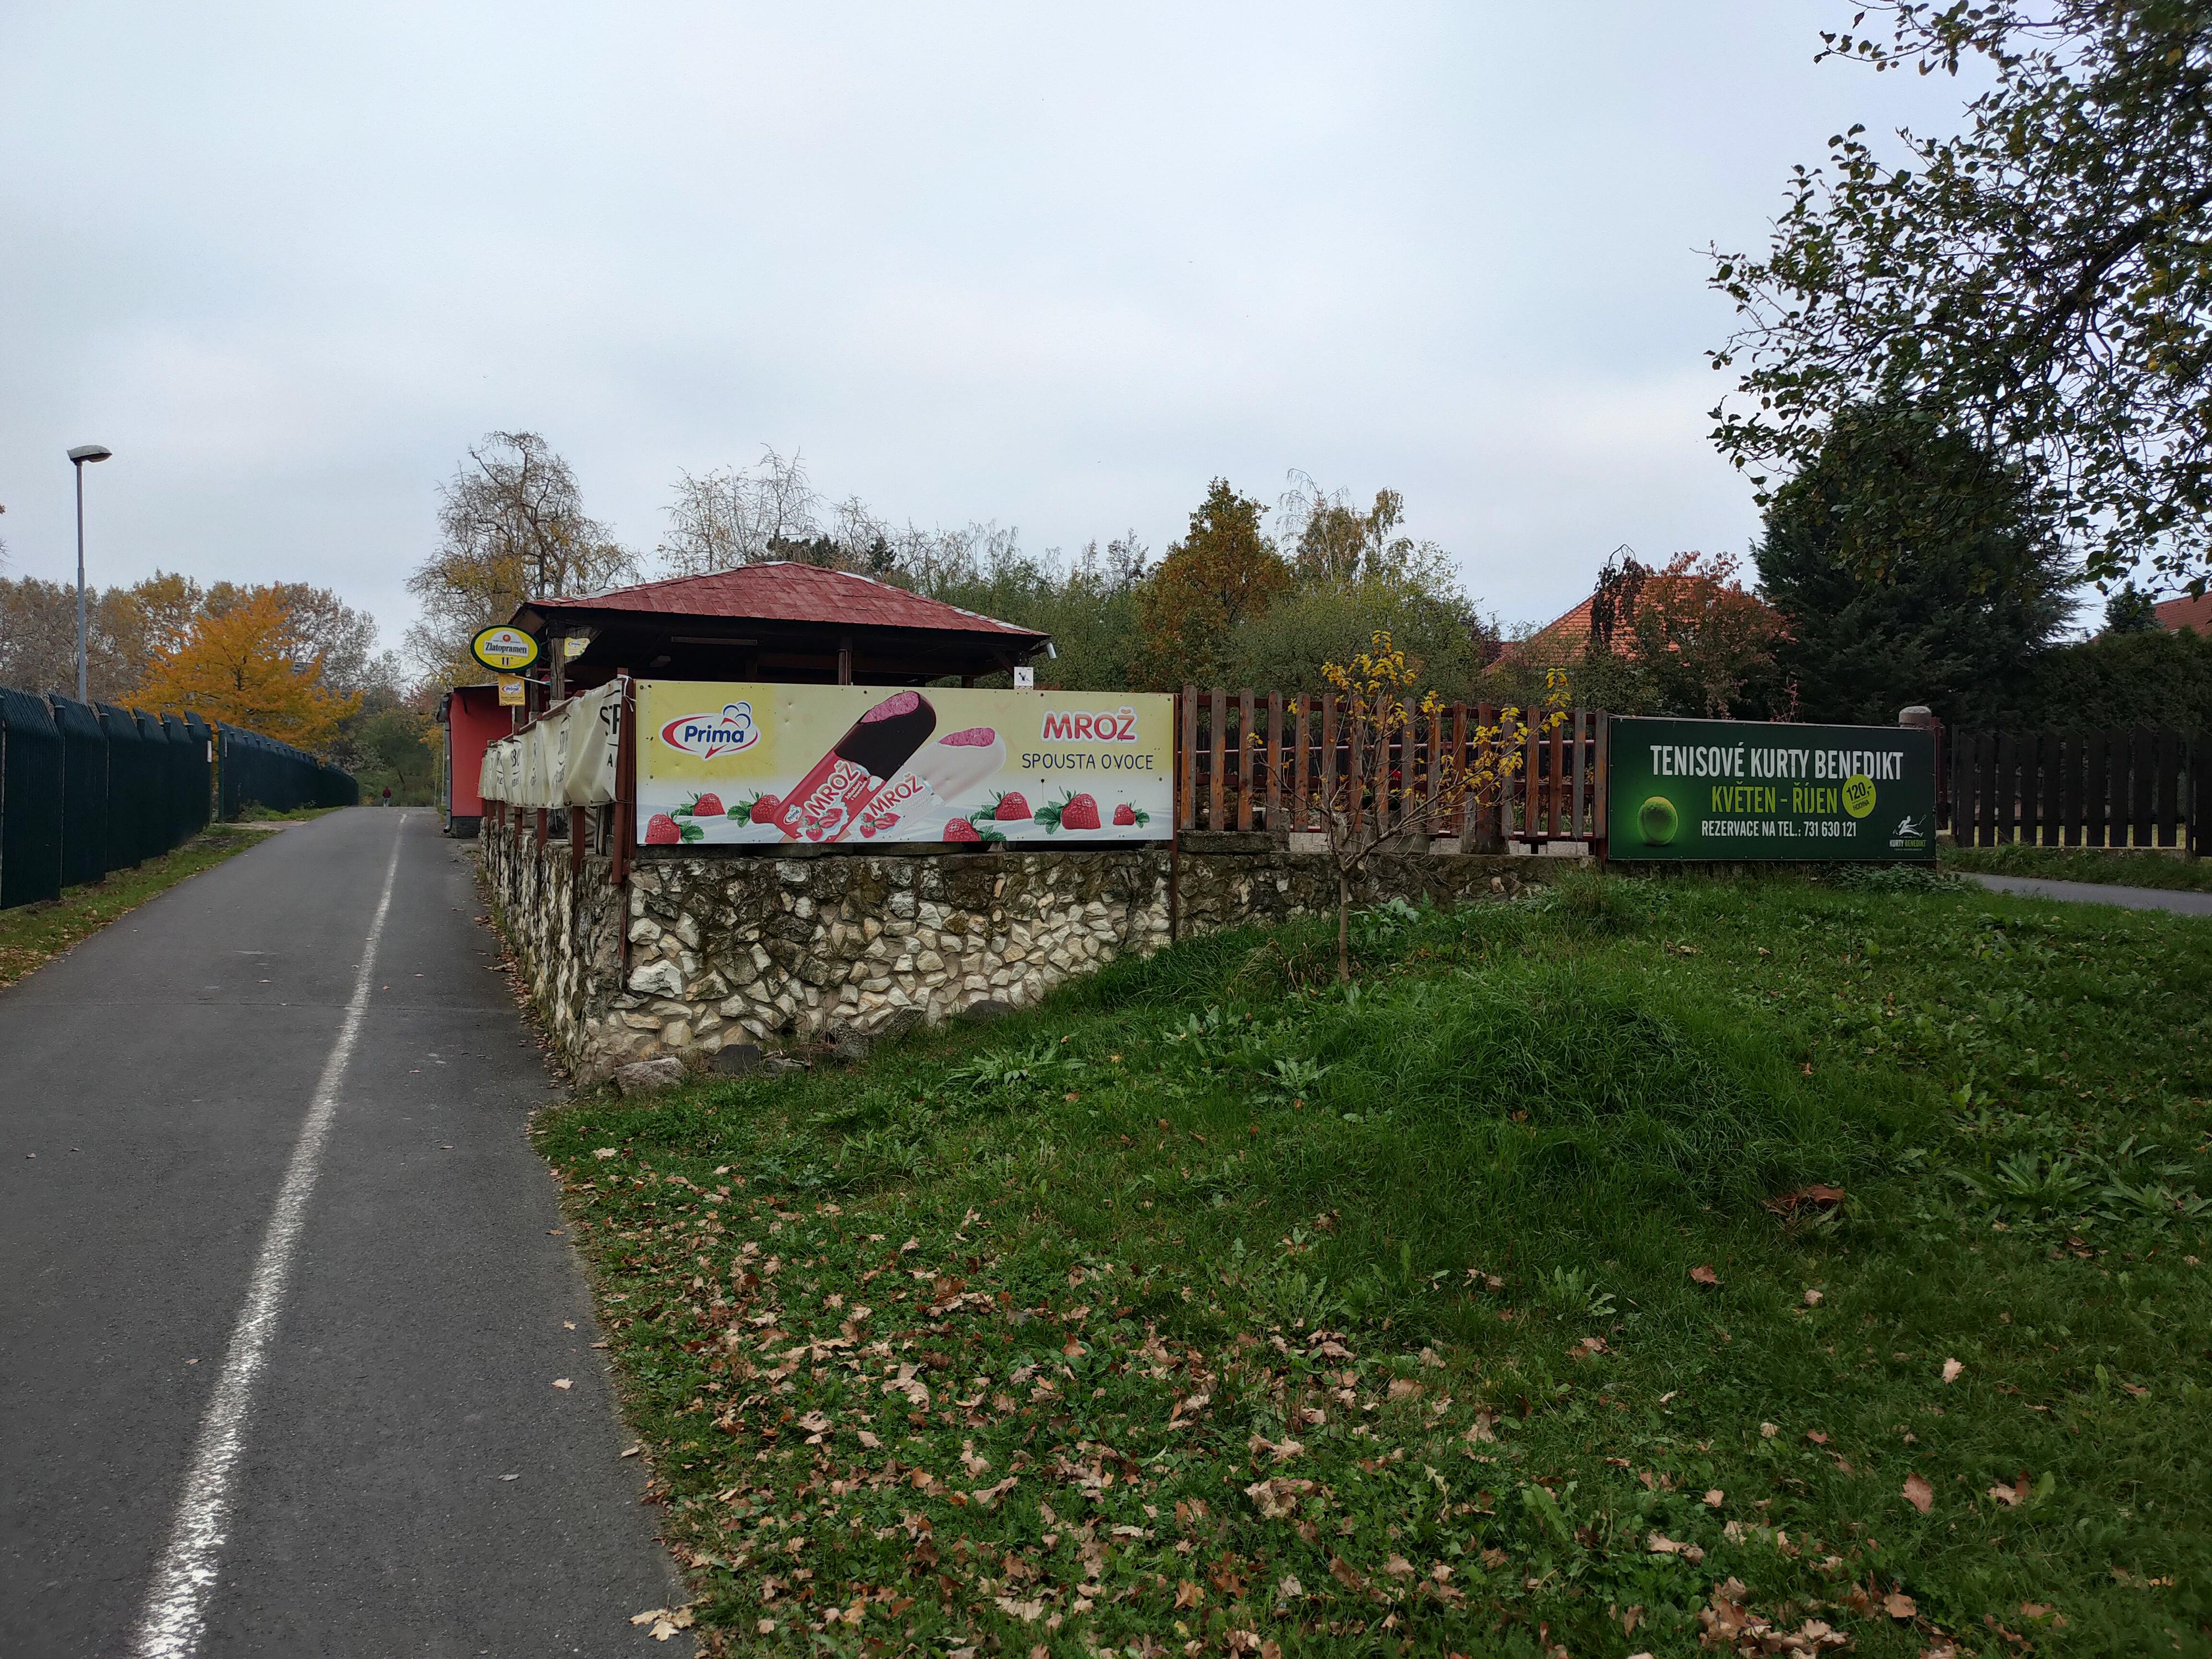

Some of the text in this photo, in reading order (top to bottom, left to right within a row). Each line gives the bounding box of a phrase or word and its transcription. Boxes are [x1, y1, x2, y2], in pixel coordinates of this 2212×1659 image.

[486, 642, 527, 654] Zlatopramen
[1042, 708, 1135, 740] MROŽ
[684, 725, 744, 743] Prima
[1022, 753, 1154, 769] SPOUSTA OVOCE
[1650, 742, 1903, 780] TENISOVÉ KURTY BENEDIKT
[806, 761, 859, 816] MROŽ
[869, 773, 924, 816] MROŽ
[1712, 781, 1776, 813] KVĚTEN
[1793, 782, 1837, 813] ŘÍJEN
[1853, 799, 1870, 811] HODINA
[787, 809, 800, 821] Prima
[1702, 820, 1856, 837] REZERVACE NA TEL.: 731 630 121
